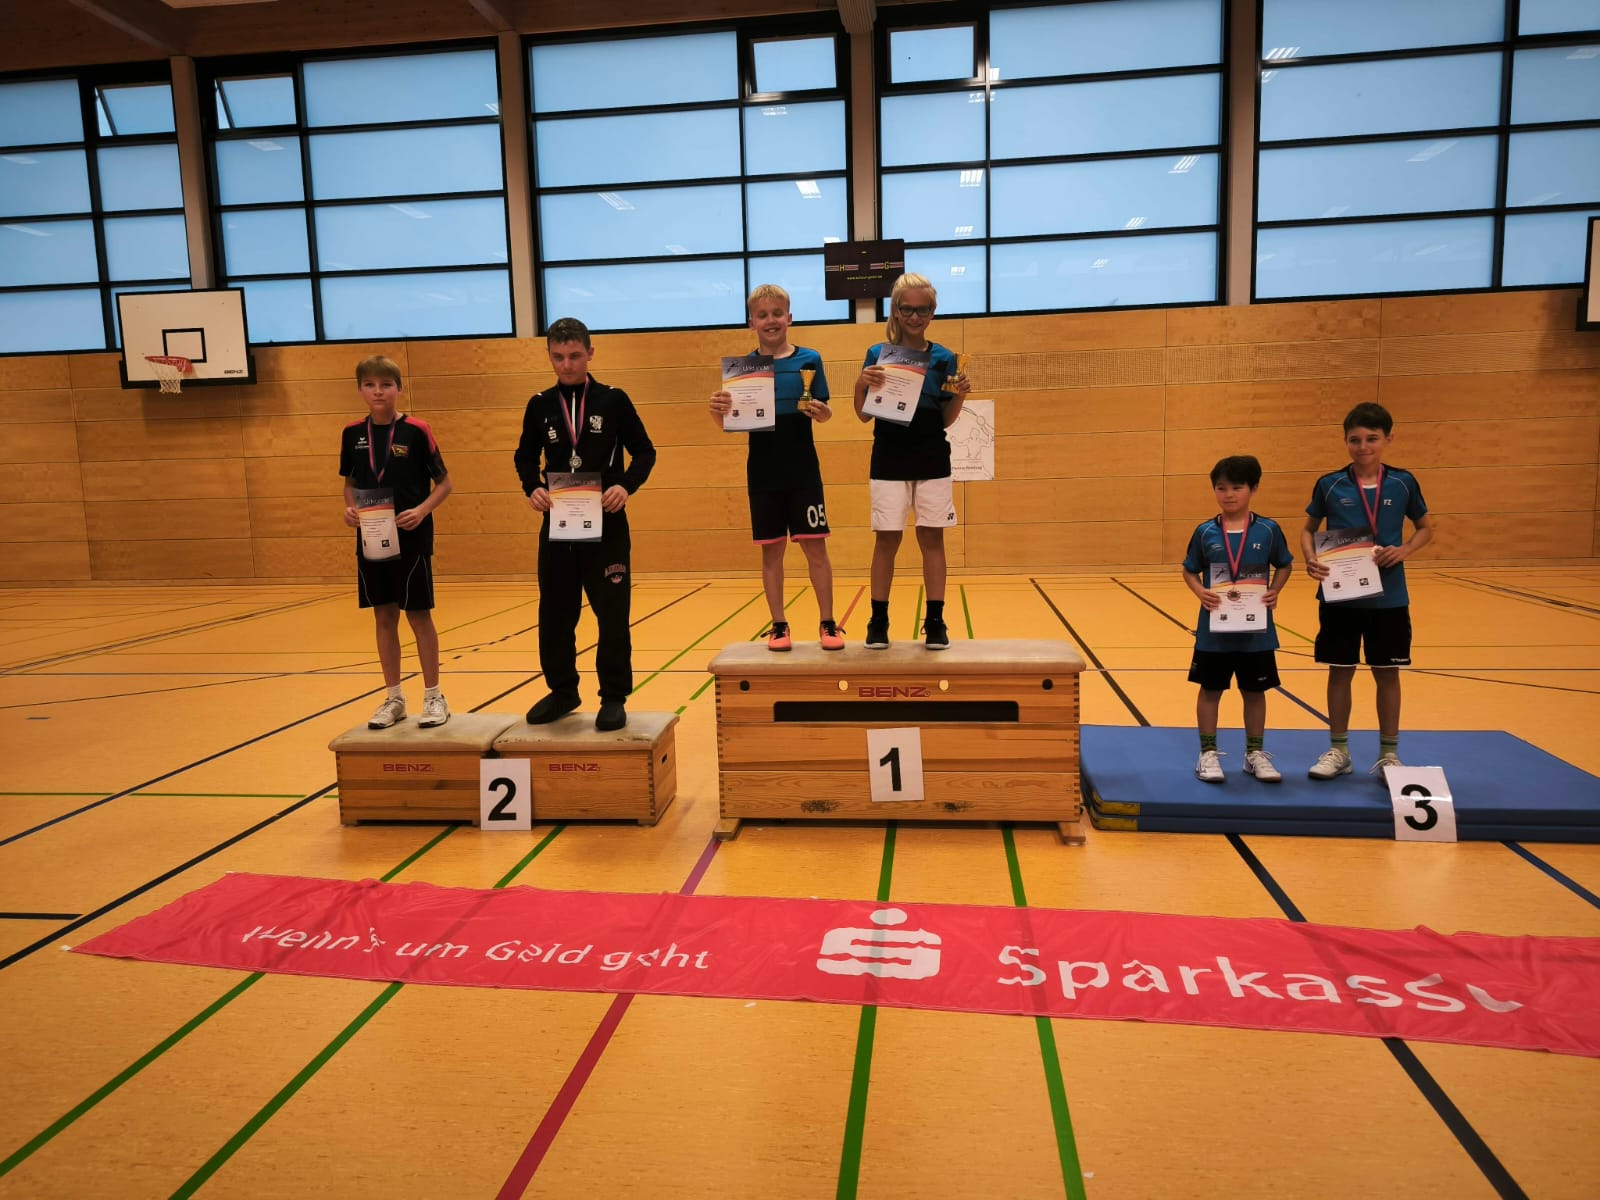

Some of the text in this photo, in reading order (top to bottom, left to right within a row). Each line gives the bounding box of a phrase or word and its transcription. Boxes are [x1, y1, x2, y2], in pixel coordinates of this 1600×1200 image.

[1383, 498, 1393, 506] FZ
[806, 504, 827, 528] 05
[858, 686, 926, 698] BENZ
[383, 763, 432, 772] BENZ
[548, 763, 598, 772] BENZ
[879, 747, 902, 792] 1
[487, 777, 517, 821] 2
[1400, 784, 1438, 831] 3
[395, 942, 470, 958] um
[485, 940, 594, 964] Geld
[600, 942, 713, 971] geht
